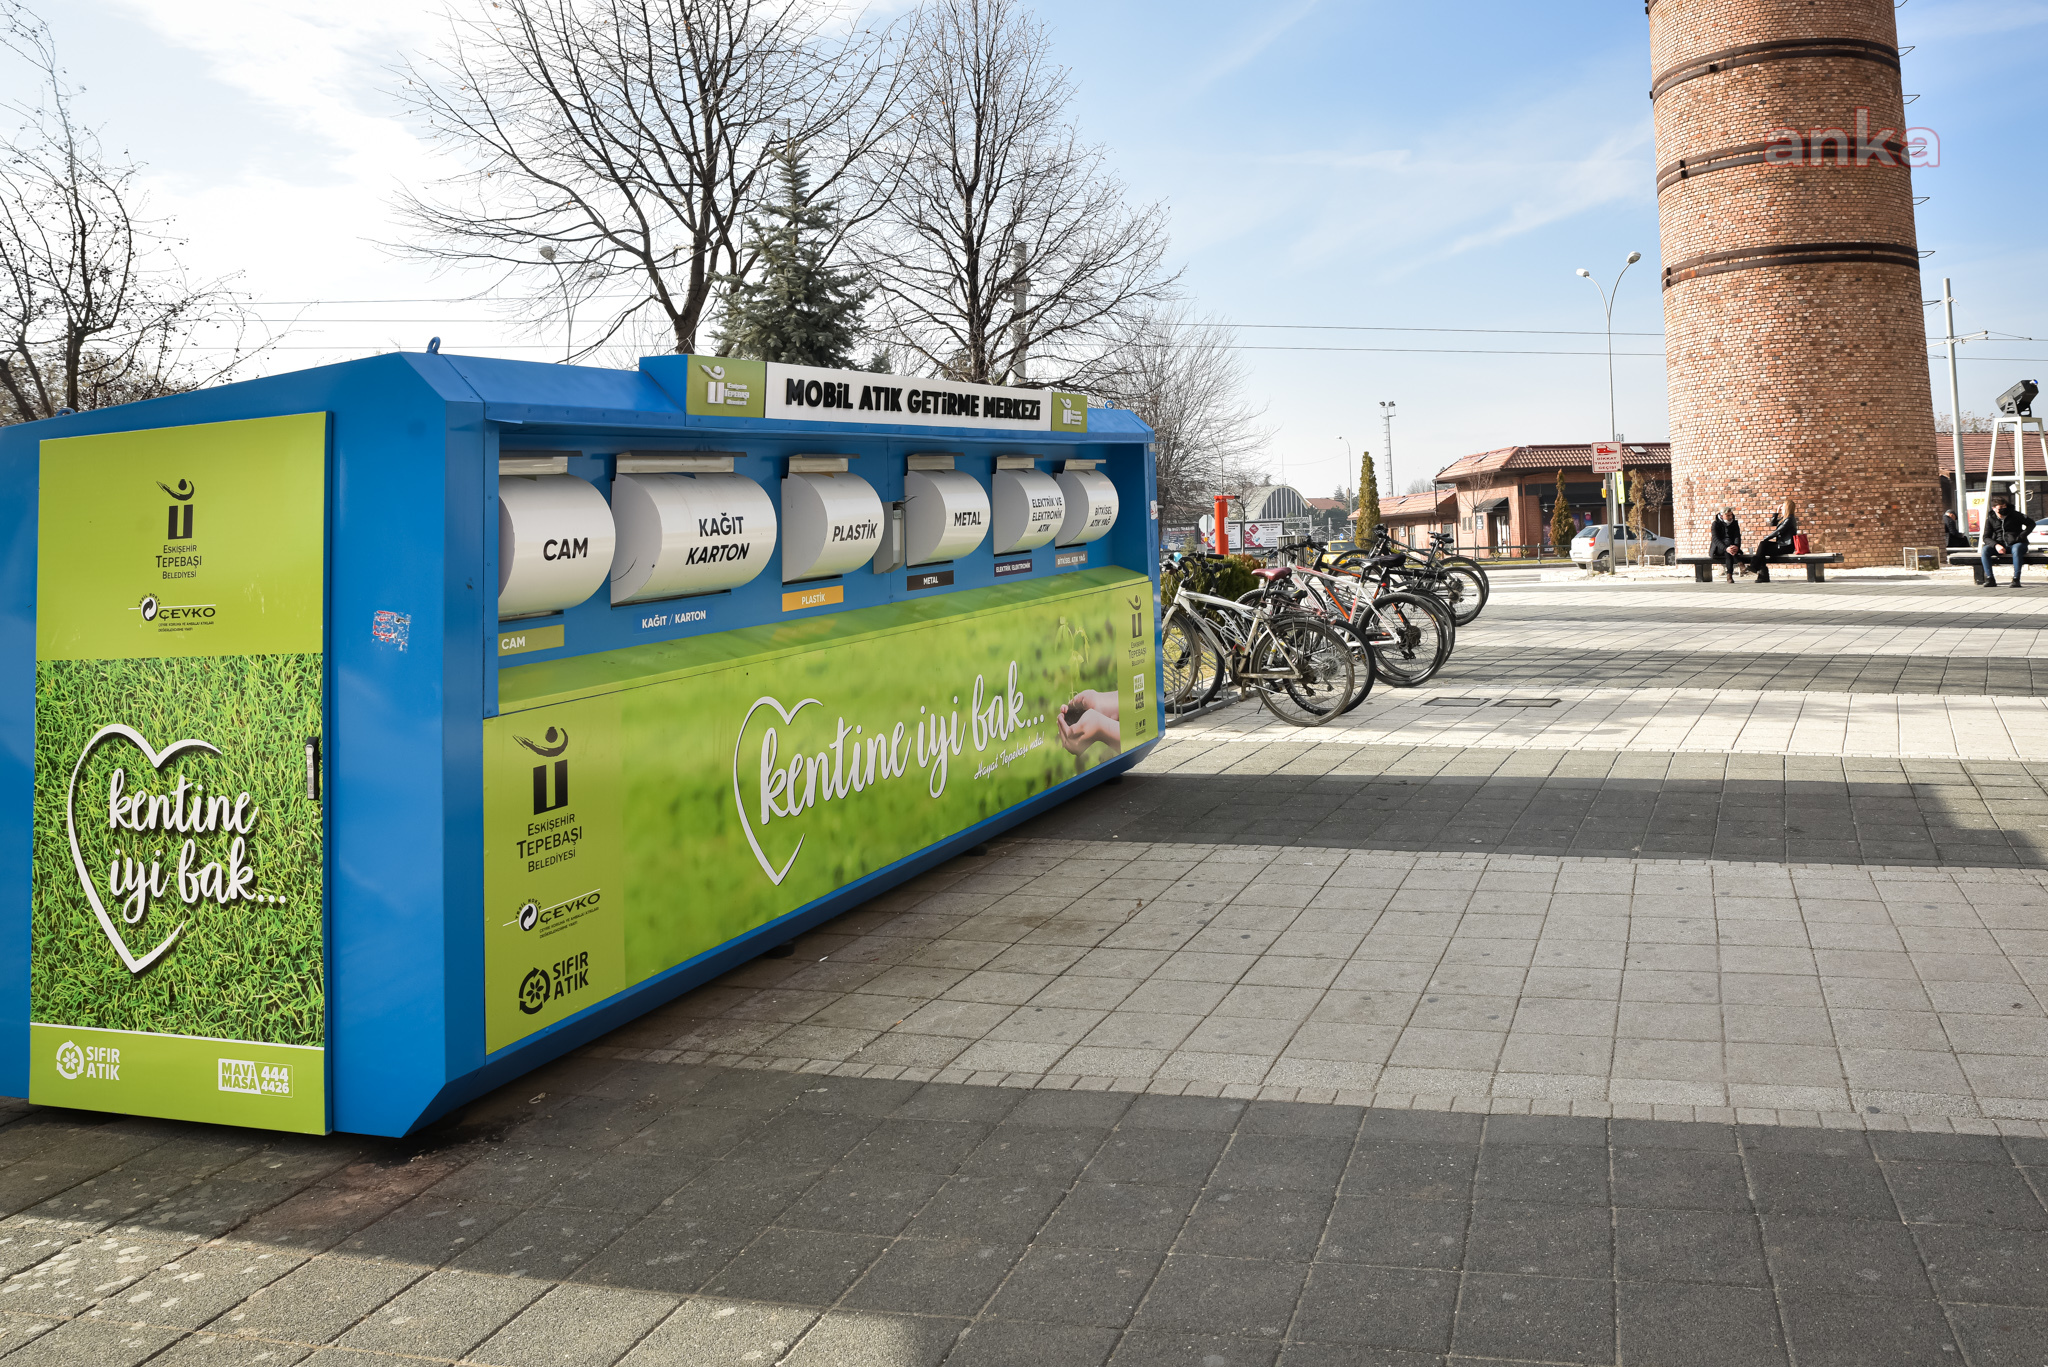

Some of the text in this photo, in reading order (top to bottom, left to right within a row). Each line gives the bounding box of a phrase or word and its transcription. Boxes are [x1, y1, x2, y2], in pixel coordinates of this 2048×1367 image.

[785, 377, 853, 409] MOBİL
[858, 385, 903, 412] ATIK
[907, 389, 980, 417] GETİRME
[983, 395, 1041, 420] MERKEZİ
[1031, 495, 1063, 508] ELEKTRİK VE
[1094, 505, 1112, 516] BİTKİSEL
[953, 511, 982, 528] METAL
[1032, 508, 1063, 521] ELEKTRONİK
[1089, 519, 1101, 527] ATIK
[698, 512, 744, 537] KAĞIT
[831, 518, 879, 543] PLASTİK
[1037, 523, 1051, 533] ATIK
[543, 537, 588, 561] CAM
[685, 542, 750, 565] KARTON
[1012, 561, 1031, 570] ELEKTRONİK
[1057, 557, 1071, 565] BİTKİSEL
[923, 575, 939, 585] METAL
[801, 591, 826, 606] PLASTİK
[158, 607, 216, 621] ÇEVKO
[642, 614, 667, 629] KAĞIT
[675, 610, 707, 625] KARTON
[501, 636, 526, 650] CAM
[760, 660, 1045, 825] kentine iyi bak...
[974, 753, 999, 780] Hayat
[109, 768, 259, 834] kentine
[516, 826, 583, 859] TEPEBAŞI
[110, 837, 286, 923] iyi bak...
[540, 893, 600, 924] ÇEVKO
[552, 951, 589, 980] SIFIR
[553, 968, 590, 1001] ATIK
[86, 1046, 120, 1064] SIFIR
[86, 1062, 120, 1081] ATIK
[261, 1066, 289, 1082] 444
[222, 1075, 258, 1091] MASA
[261, 1080, 290, 1094] 4426
